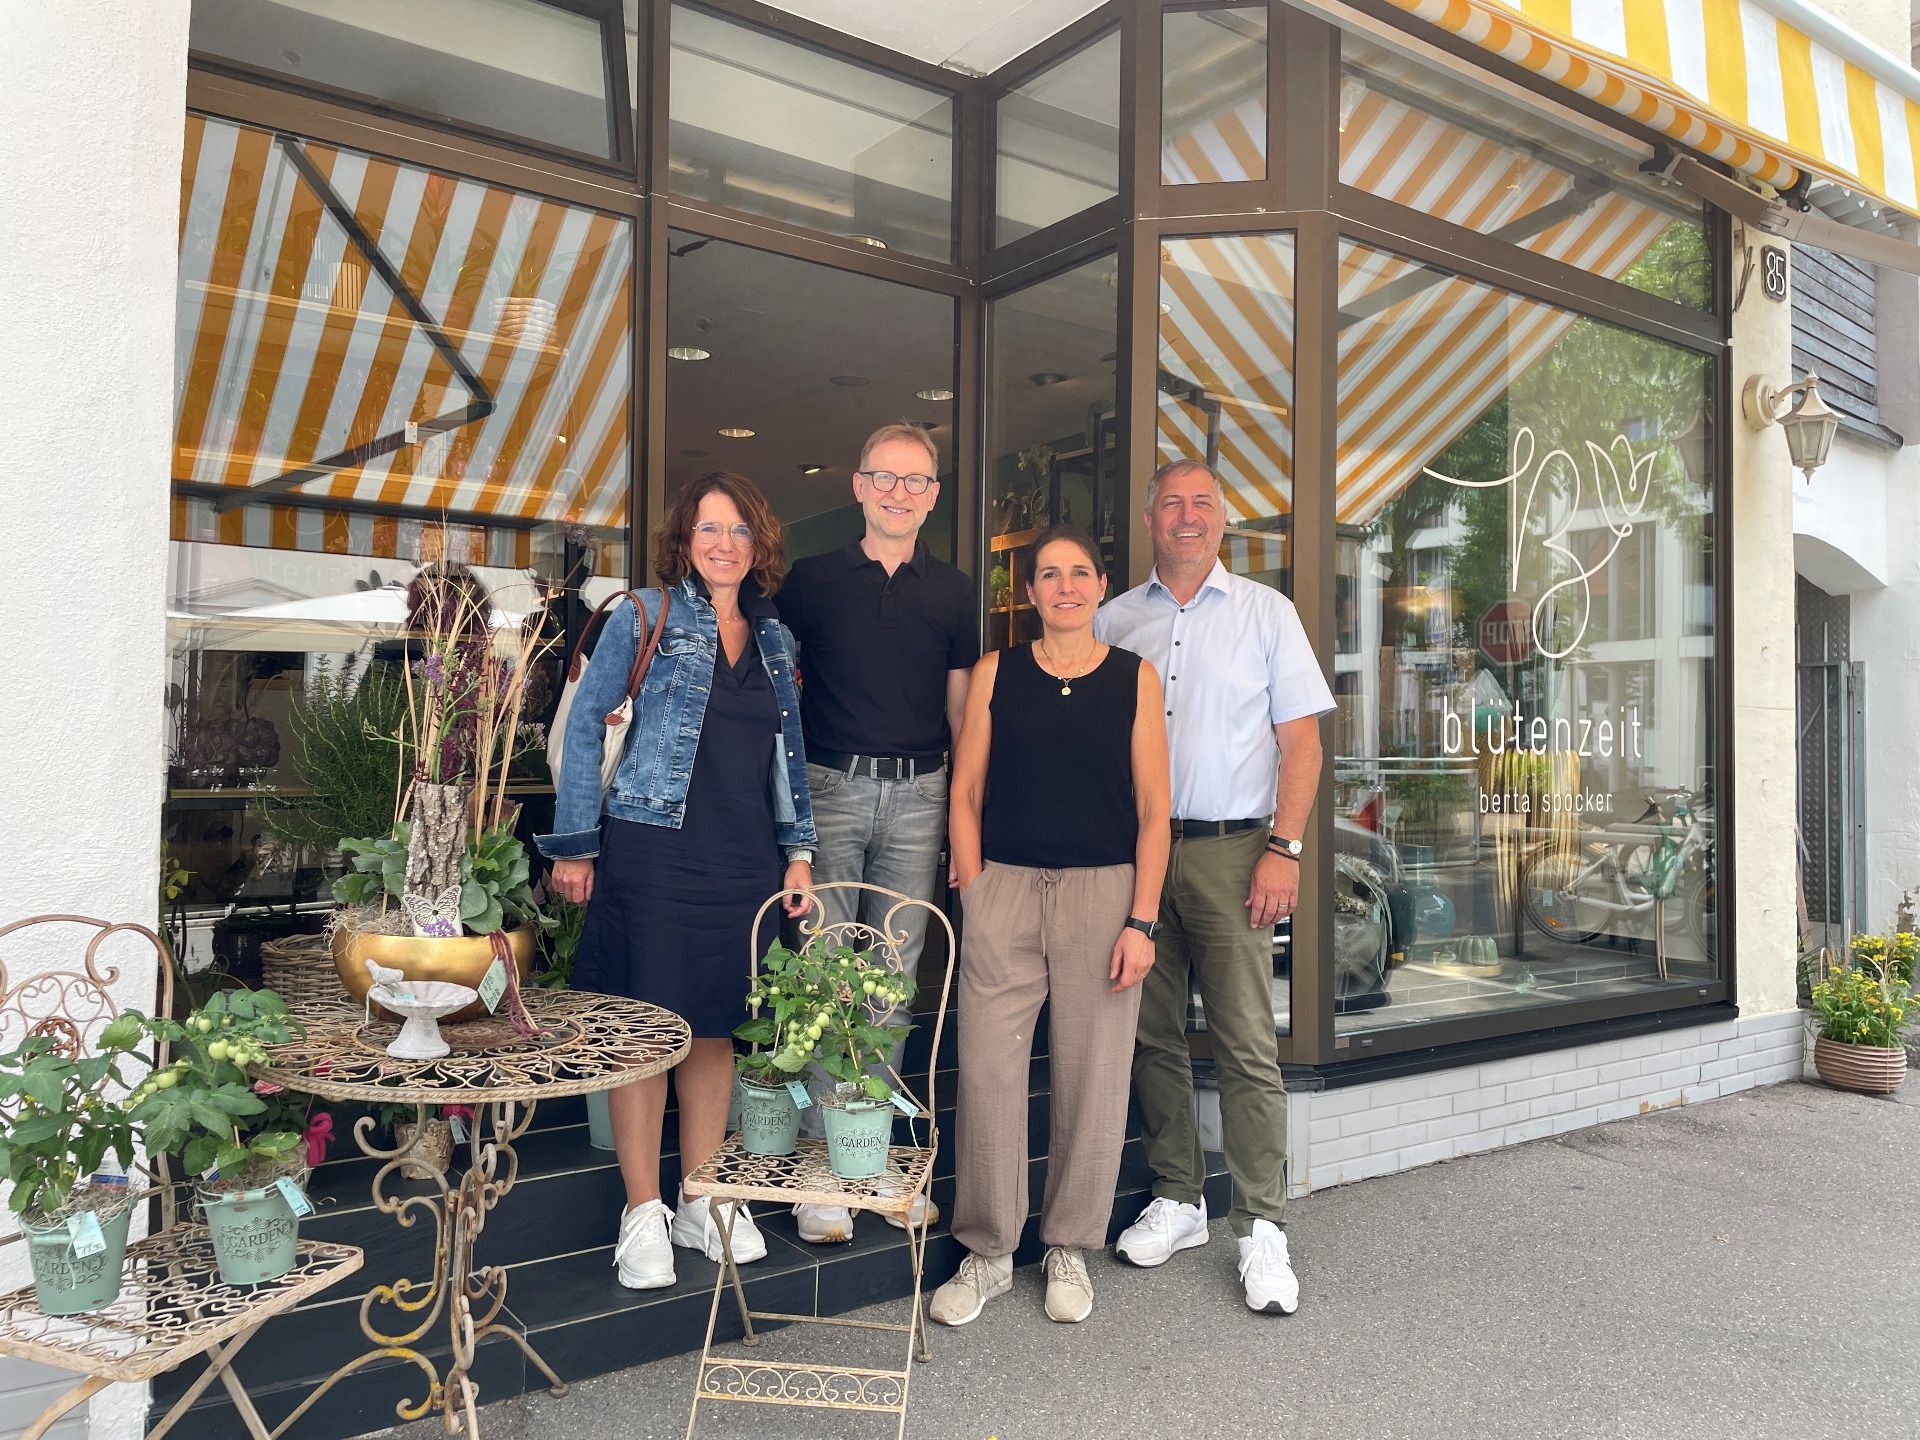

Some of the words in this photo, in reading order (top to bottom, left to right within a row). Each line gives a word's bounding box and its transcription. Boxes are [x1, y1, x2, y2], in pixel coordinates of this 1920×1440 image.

[1766, 251, 1786, 296] 85
[1443, 694, 1642, 758] blütenzeit
[1480, 786, 1531, 813] berta
[1542, 785, 1613, 817] spöcker
[746, 1111, 785, 1126] GARDEN
[841, 1136, 882, 1150] GARDEN
[228, 1227, 287, 1248] GARDEN
[35, 1257, 93, 1275] GARDEN
